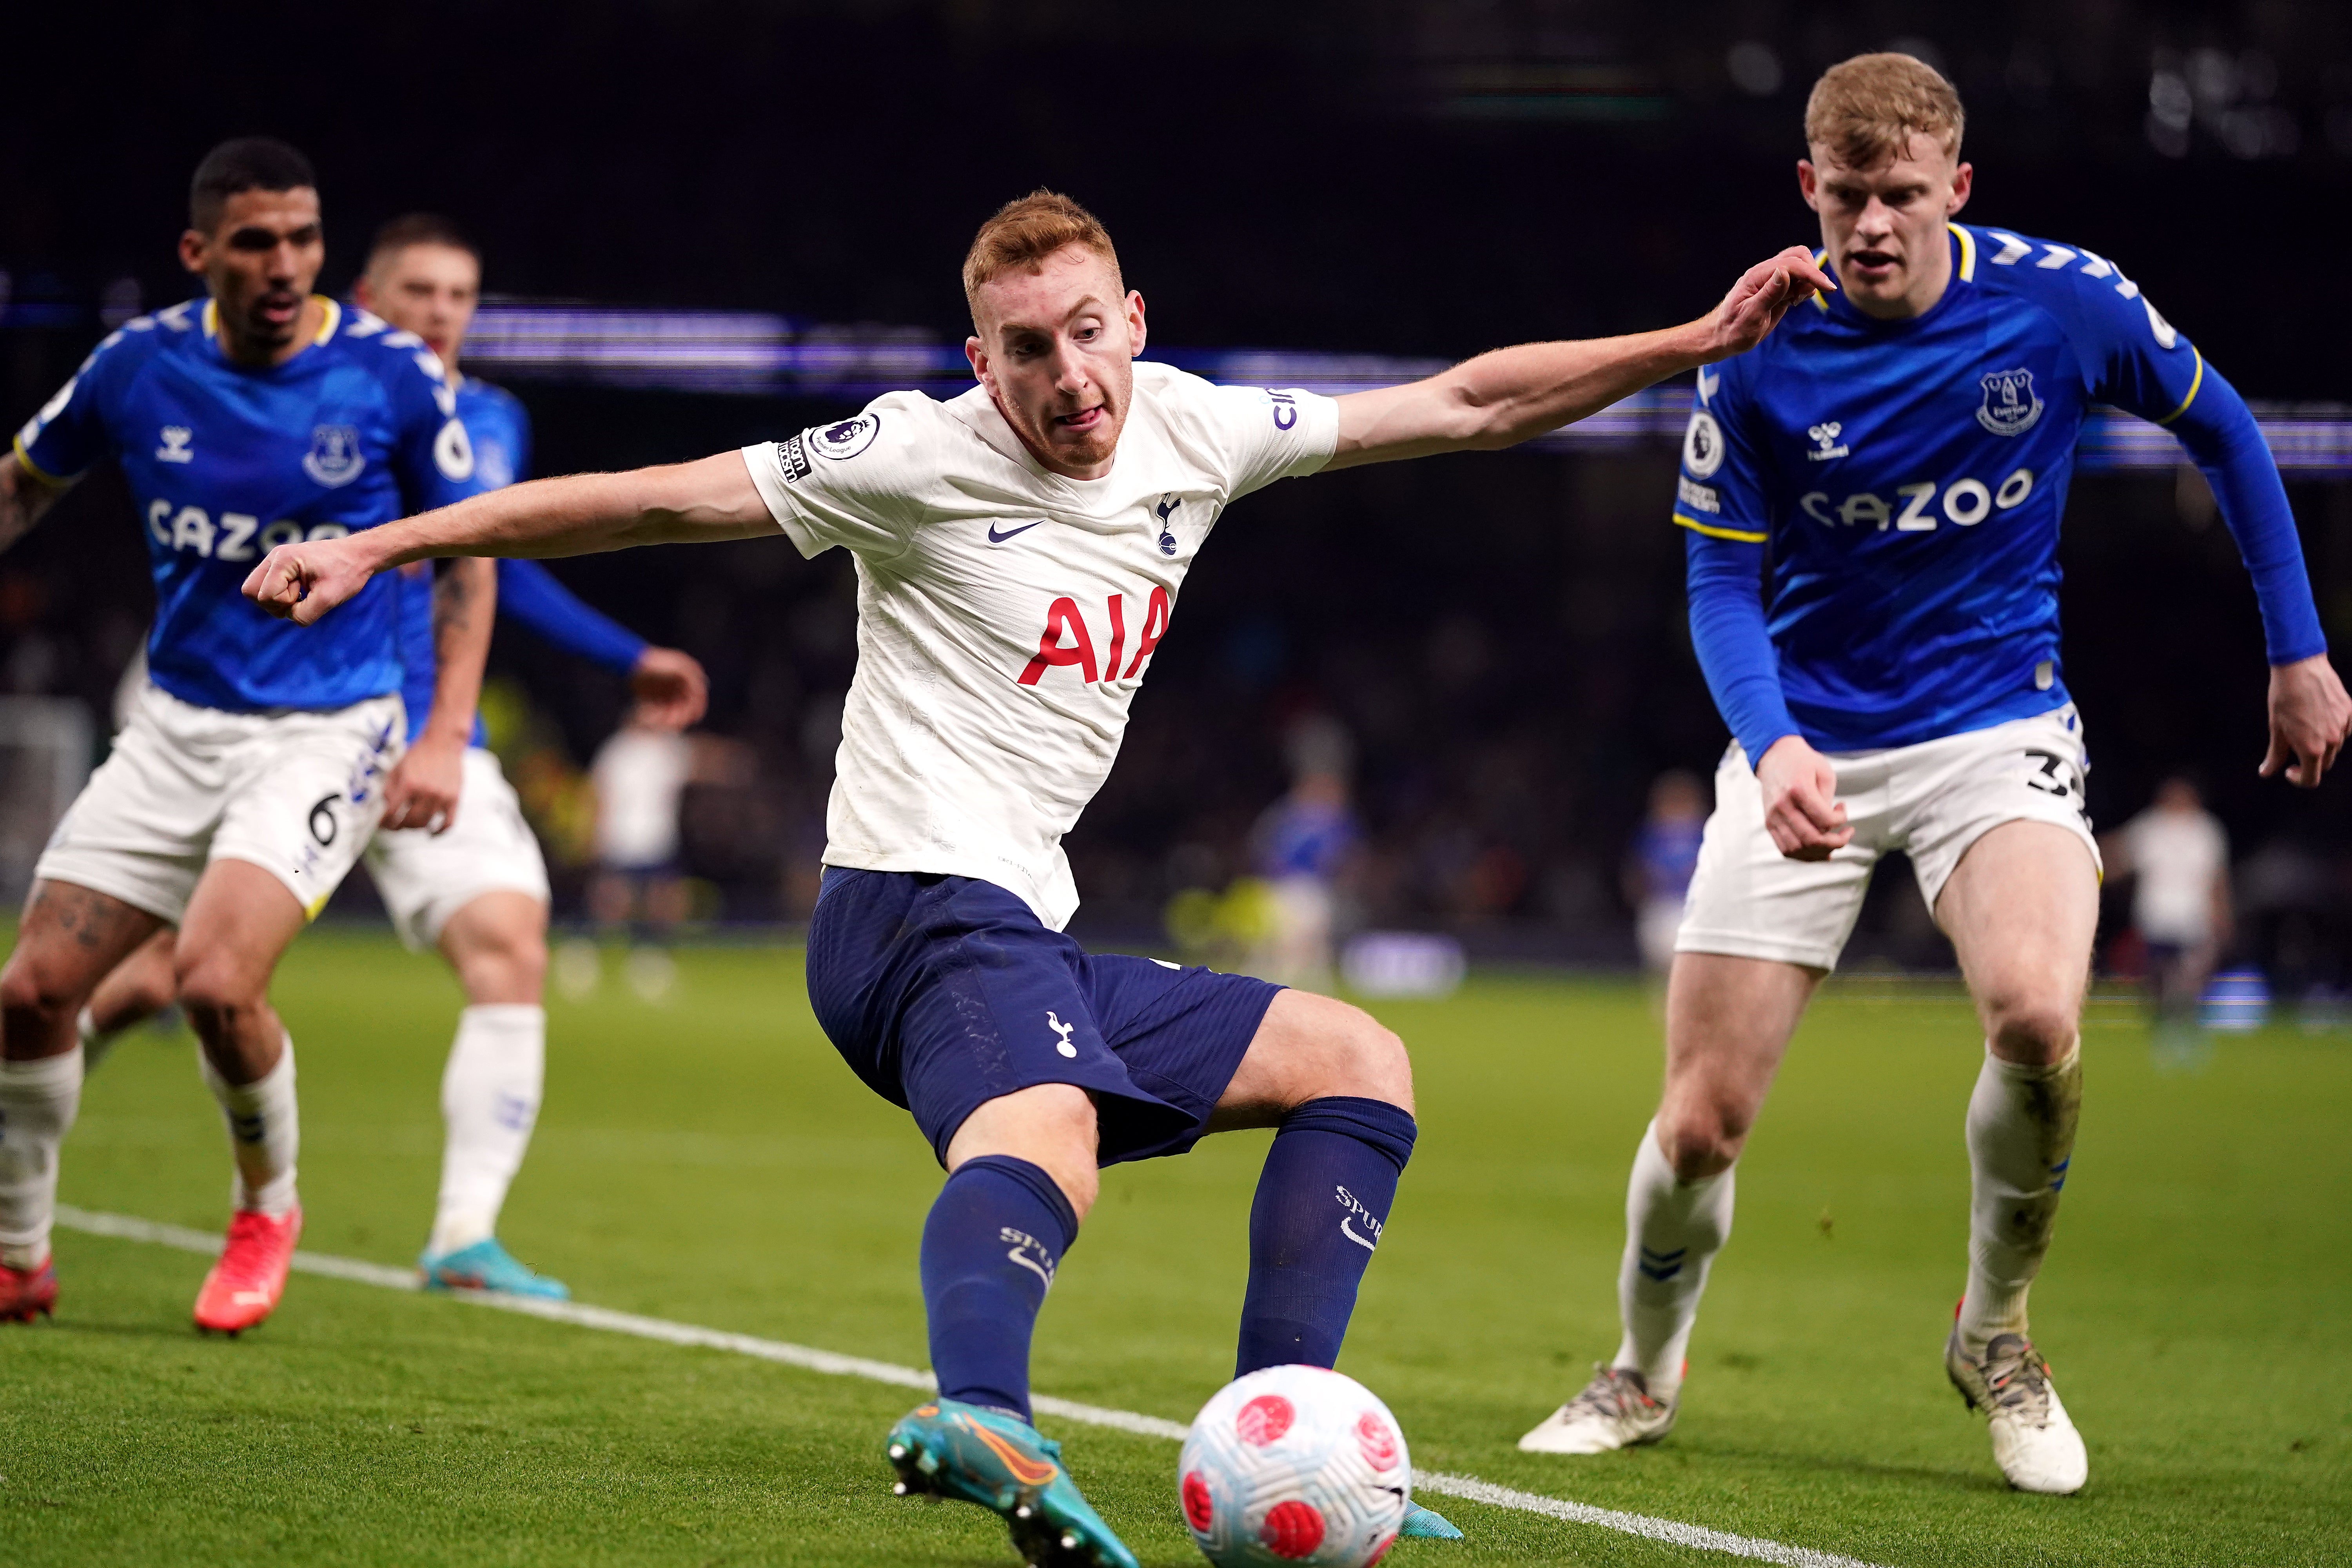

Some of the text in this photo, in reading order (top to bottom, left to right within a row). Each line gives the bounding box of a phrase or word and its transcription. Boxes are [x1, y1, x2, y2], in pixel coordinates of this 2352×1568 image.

[789, 438, 806, 471] room
[816, 437, 829, 450] Premier
[1800, 468, 2034, 532] CAZOO
[1017, 586, 1168, 685] AIA
[309, 792, 341, 847] 6
